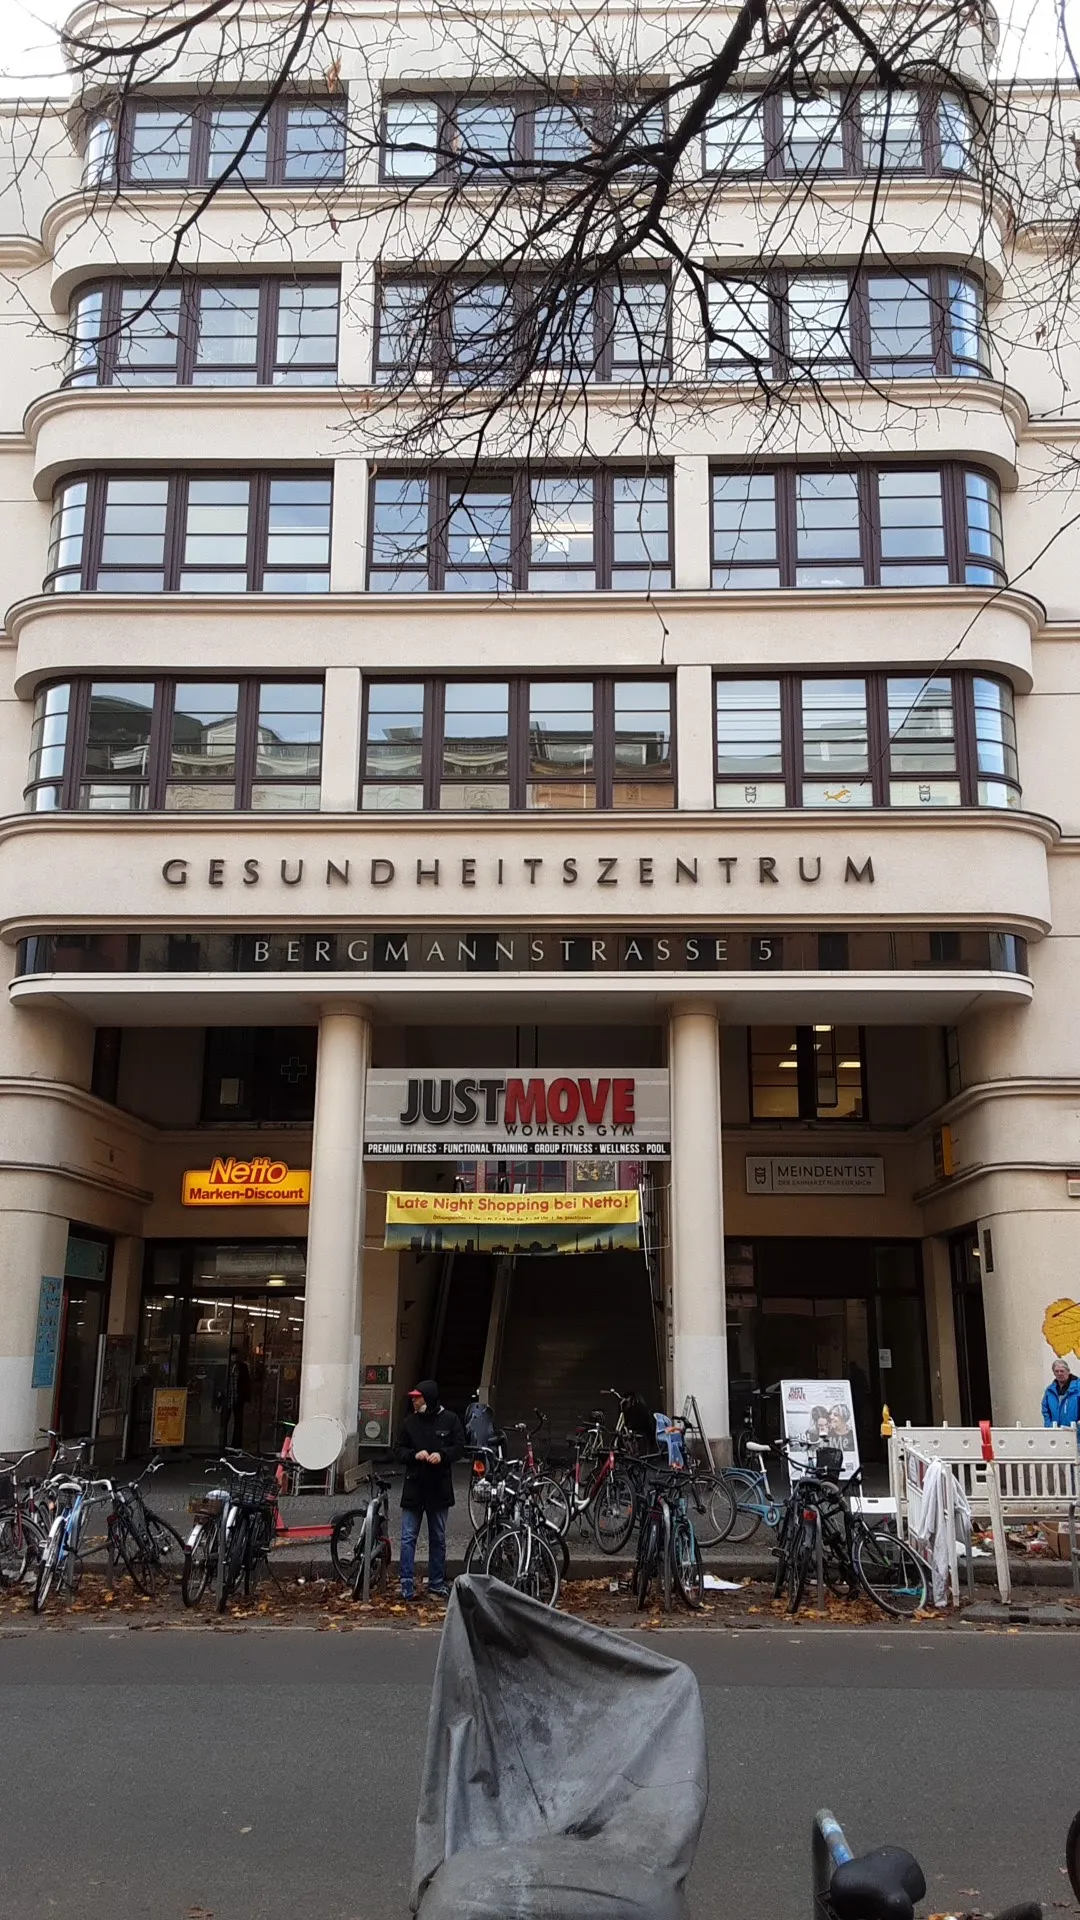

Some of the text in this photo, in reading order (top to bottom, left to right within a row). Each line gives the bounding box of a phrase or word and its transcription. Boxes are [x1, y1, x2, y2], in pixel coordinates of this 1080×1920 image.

[162, 856, 875, 885] GESUNDHEITSZENTRUM
[253, 939, 773, 962] BERGMANNSTRASSE 5
[503, 1124, 636, 1137] WOMENS GYM
[367, 1143, 667, 1154] PREMIUM FITNESS FUNCTIONAL TRAINING GROUP FITNESS WELLNESS POOL
[208, 1157, 288, 1185] Netto
[777, 1165, 876, 1178] MEINDENTIST
[189, 1187, 304, 1200] Marken-Discount
[396, 1196, 629, 1213] Late Night Shopping bei Netto!
